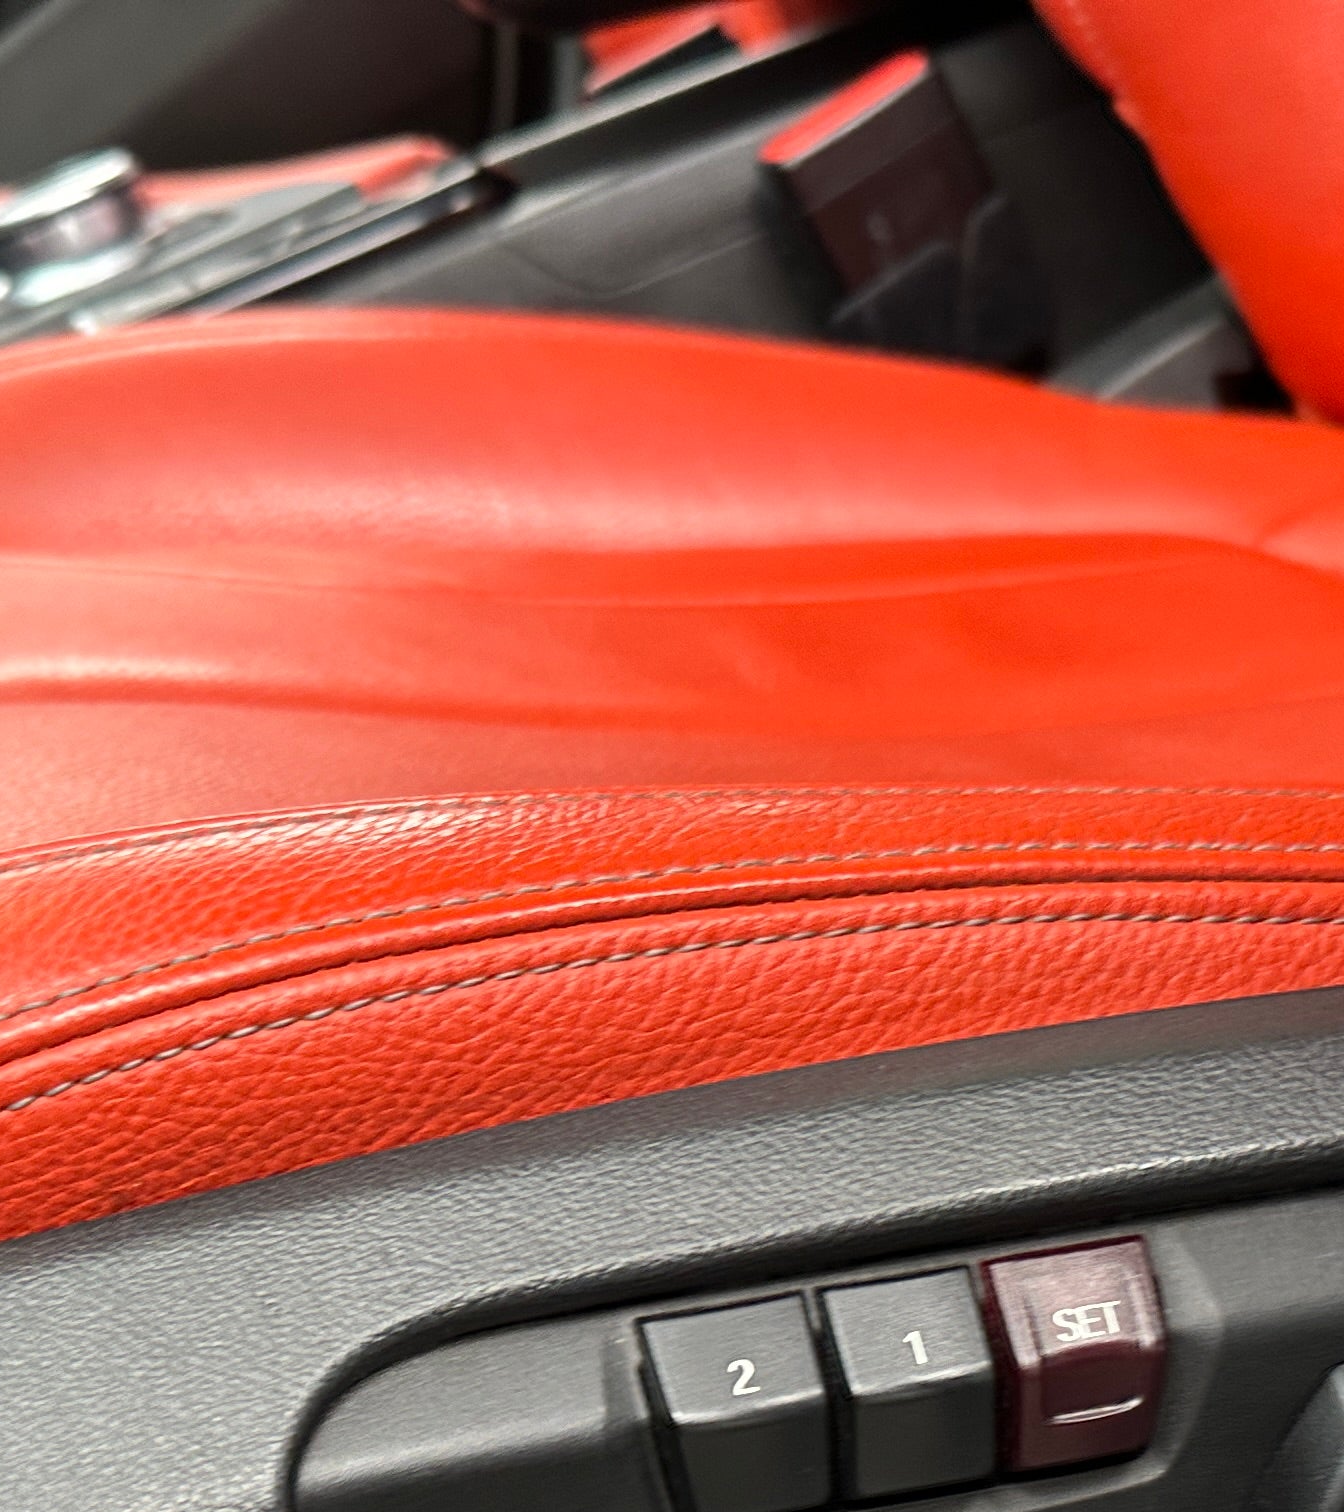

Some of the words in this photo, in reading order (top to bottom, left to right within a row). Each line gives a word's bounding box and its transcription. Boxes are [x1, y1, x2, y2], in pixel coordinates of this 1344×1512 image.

[1052, 1300, 1121, 1343] SET
[902, 1330, 929, 1365] 1
[727, 1358, 761, 1396] 2
